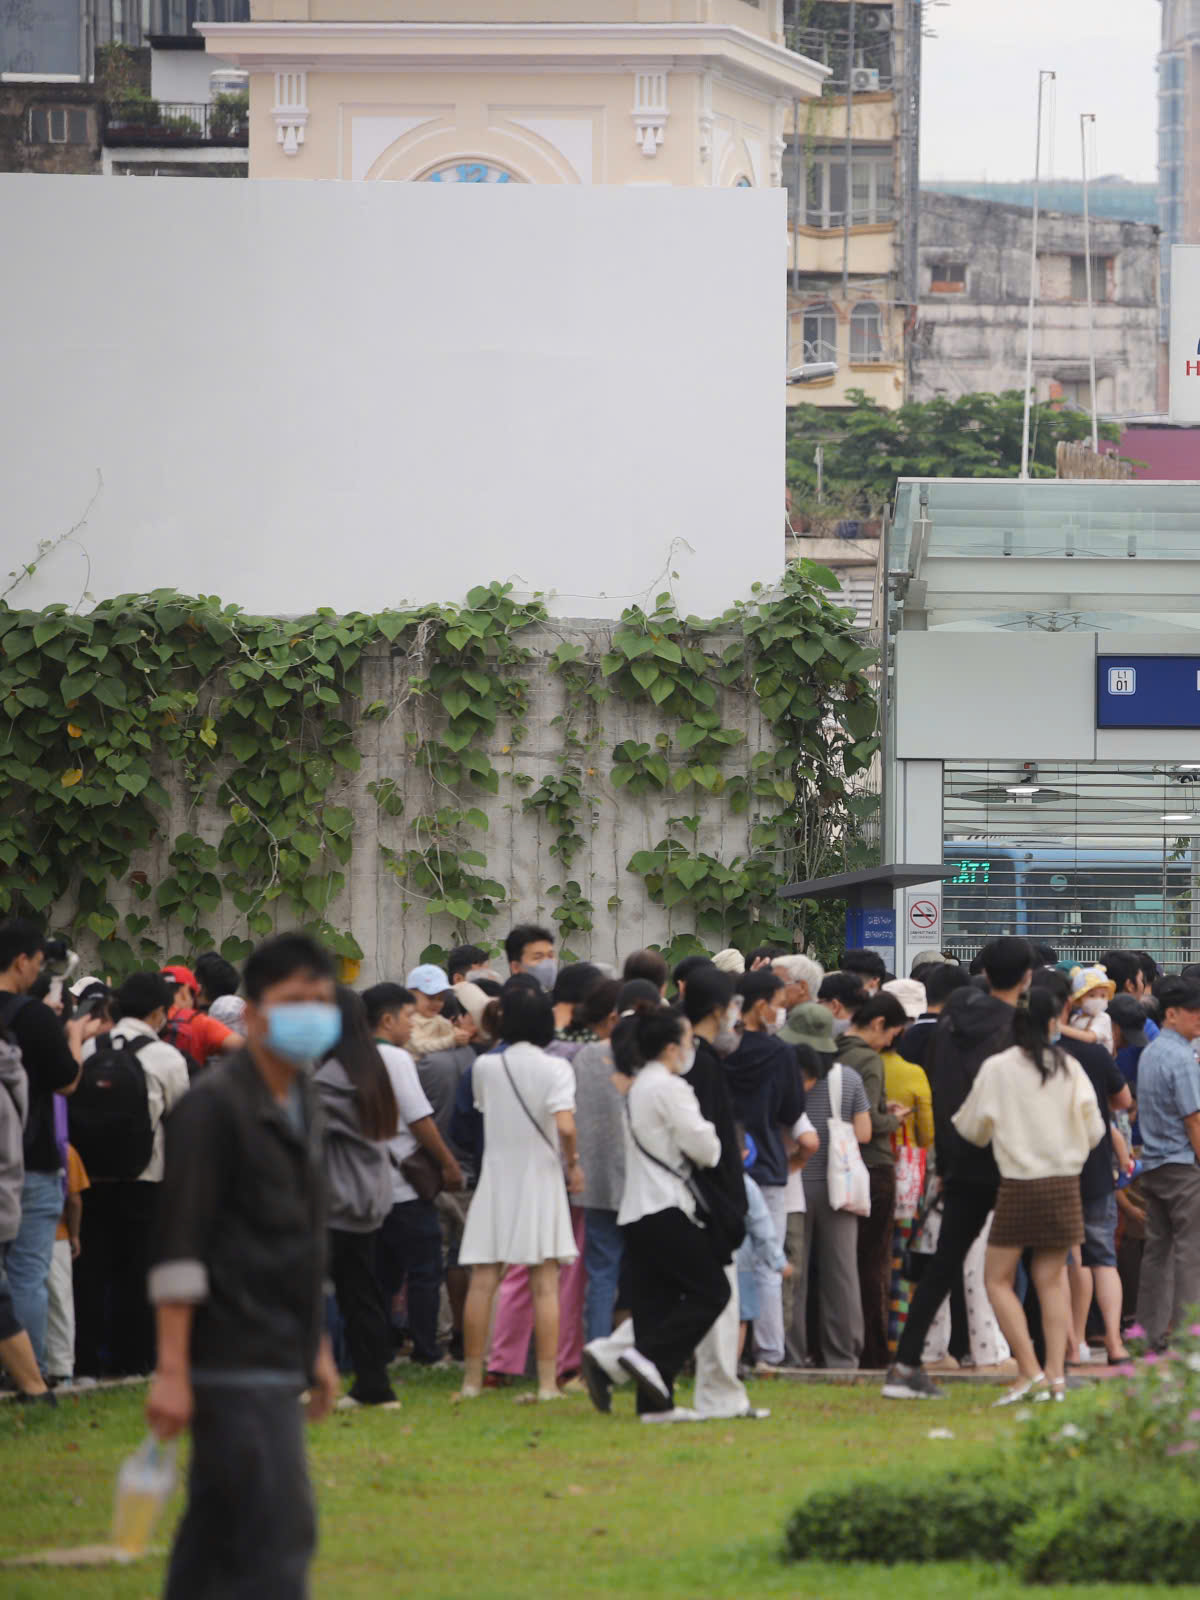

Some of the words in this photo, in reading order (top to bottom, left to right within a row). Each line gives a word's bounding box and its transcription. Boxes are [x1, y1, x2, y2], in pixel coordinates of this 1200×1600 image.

[455, 163, 489, 183] 12
[1117, 671, 1127, 679] L1
[1116, 680, 1128, 691] 01
